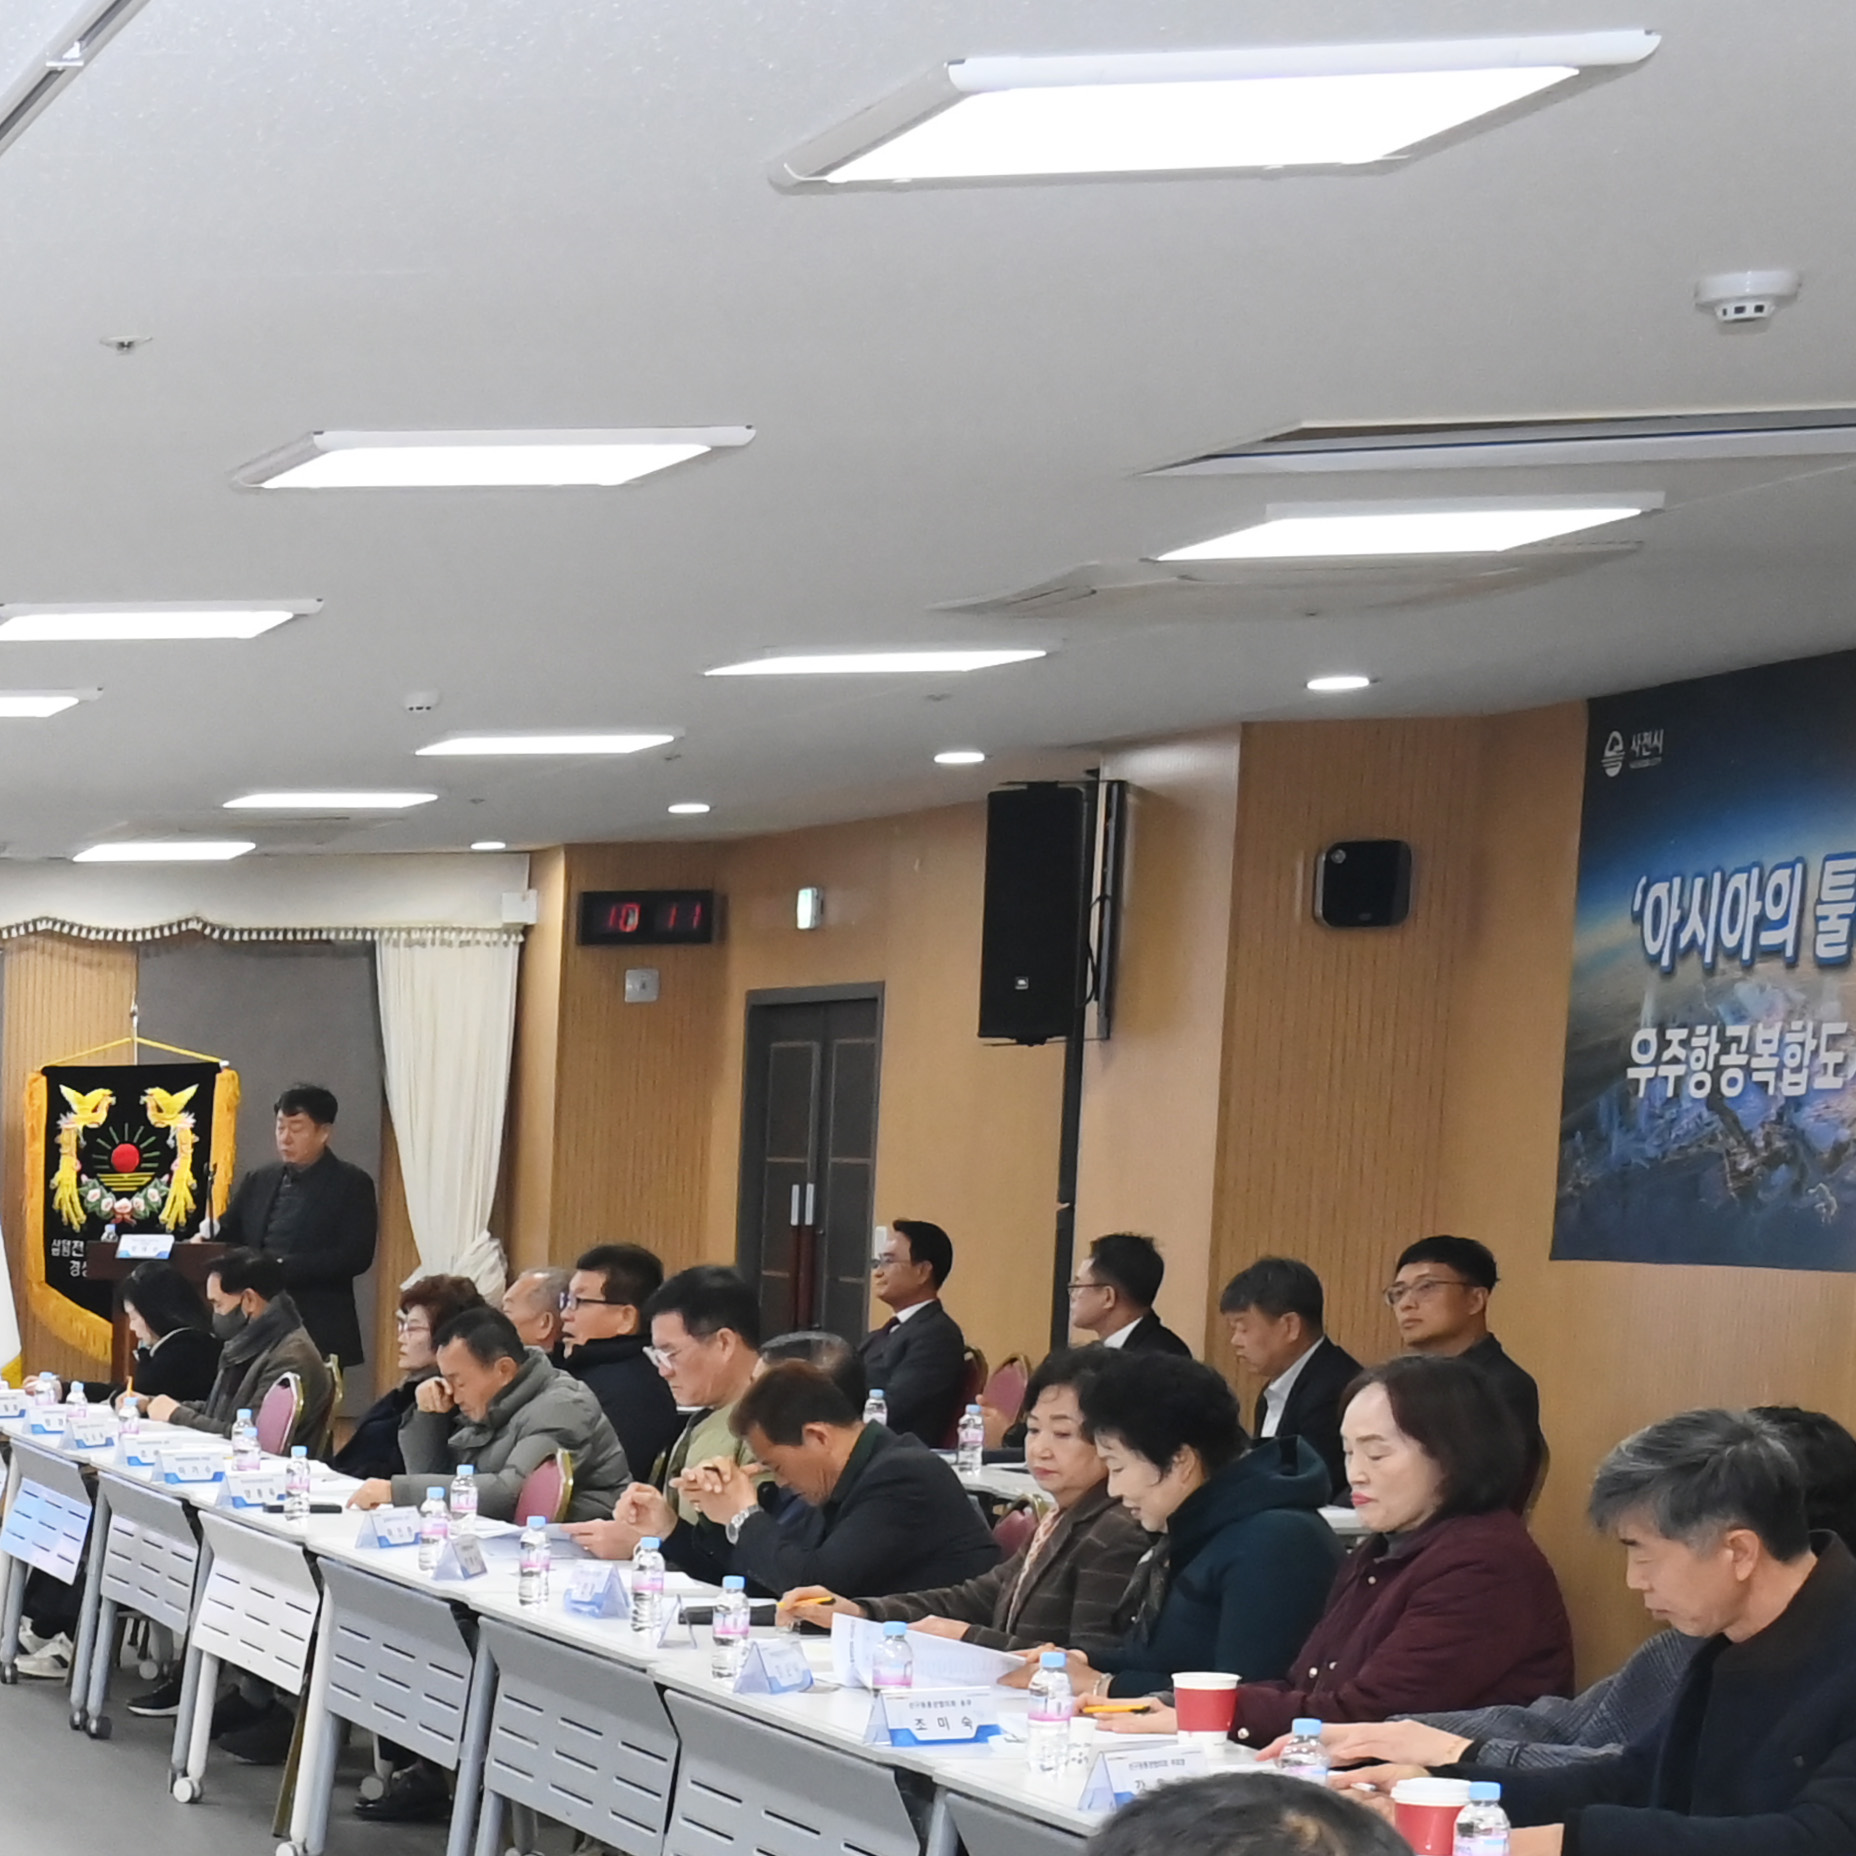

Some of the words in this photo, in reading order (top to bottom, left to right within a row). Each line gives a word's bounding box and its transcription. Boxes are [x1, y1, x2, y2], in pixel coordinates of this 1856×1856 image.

[608, 902, 641, 932] 10
[669, 901, 702, 929] 11
[1627, 1020, 1856, 1099] 우주항공복합도
